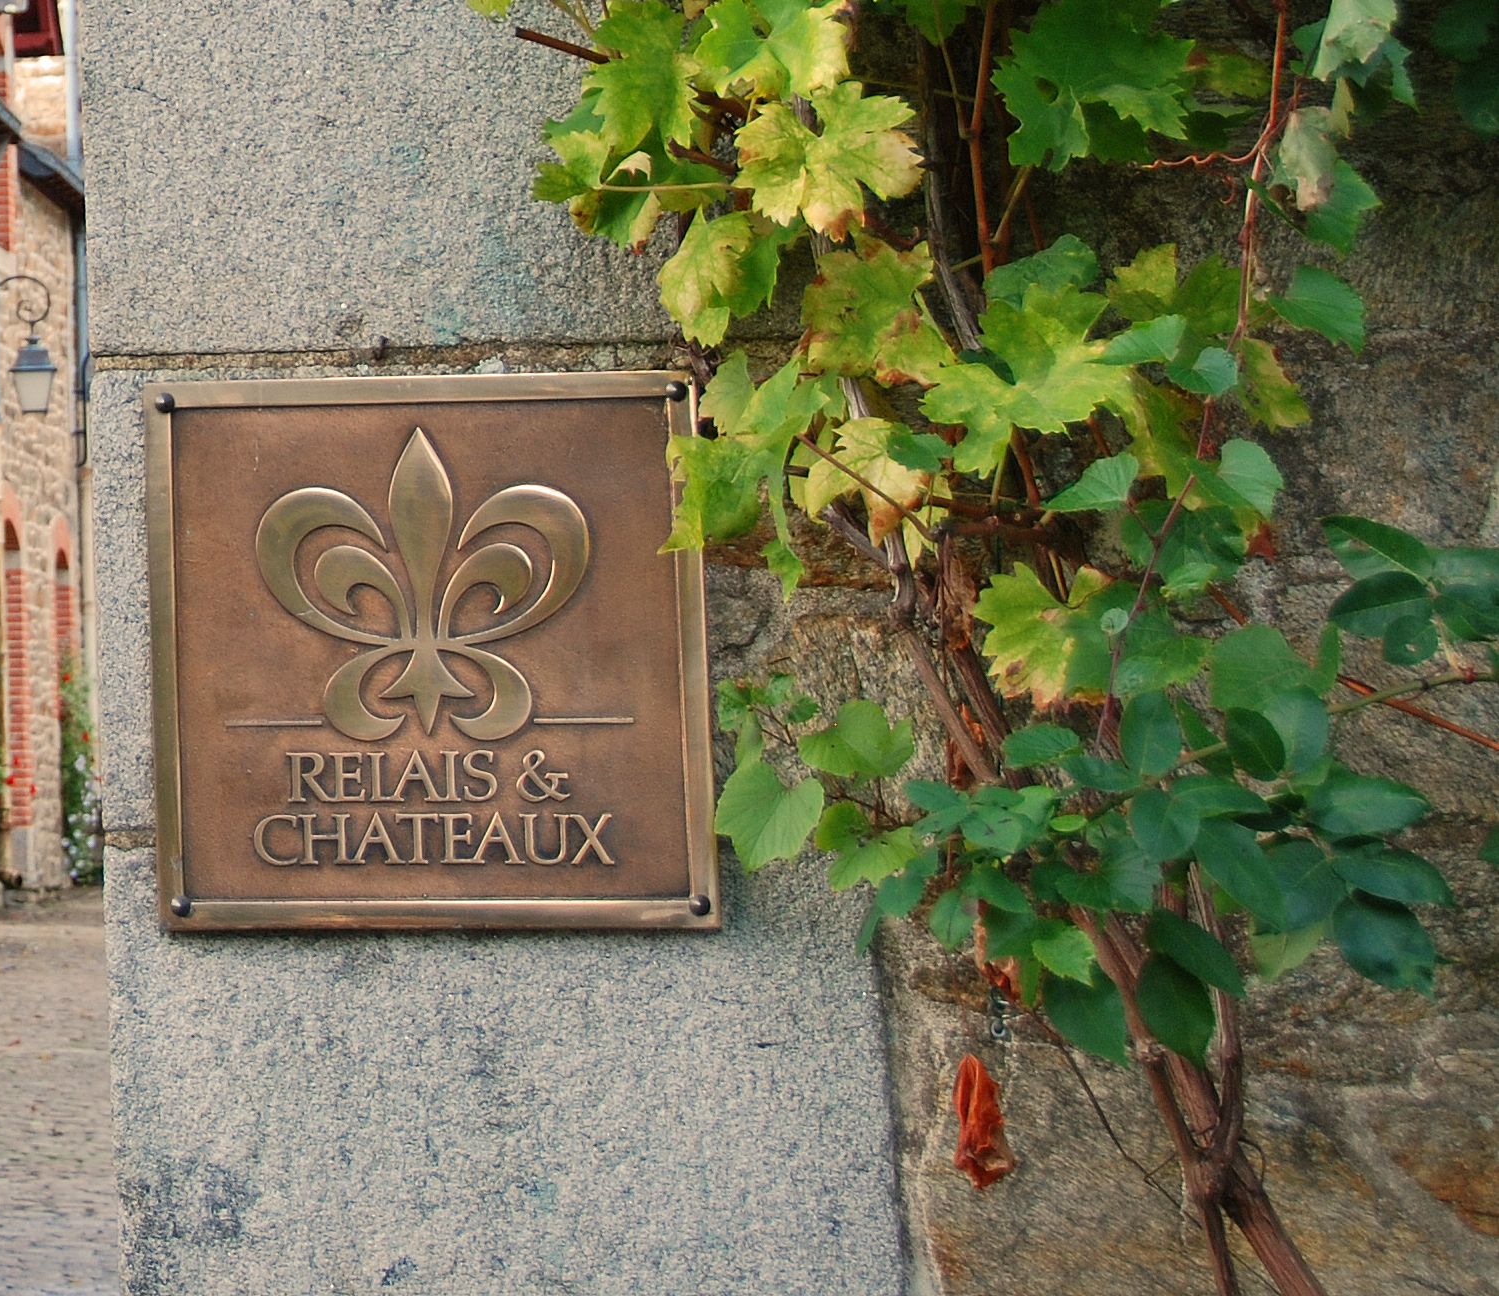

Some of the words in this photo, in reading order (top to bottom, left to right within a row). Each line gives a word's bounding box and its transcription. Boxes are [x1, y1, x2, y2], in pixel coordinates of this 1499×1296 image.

[285, 749, 498, 804] RELAIS
[515, 749, 571, 803] &
[252, 811, 615, 866] CHATEAUX
